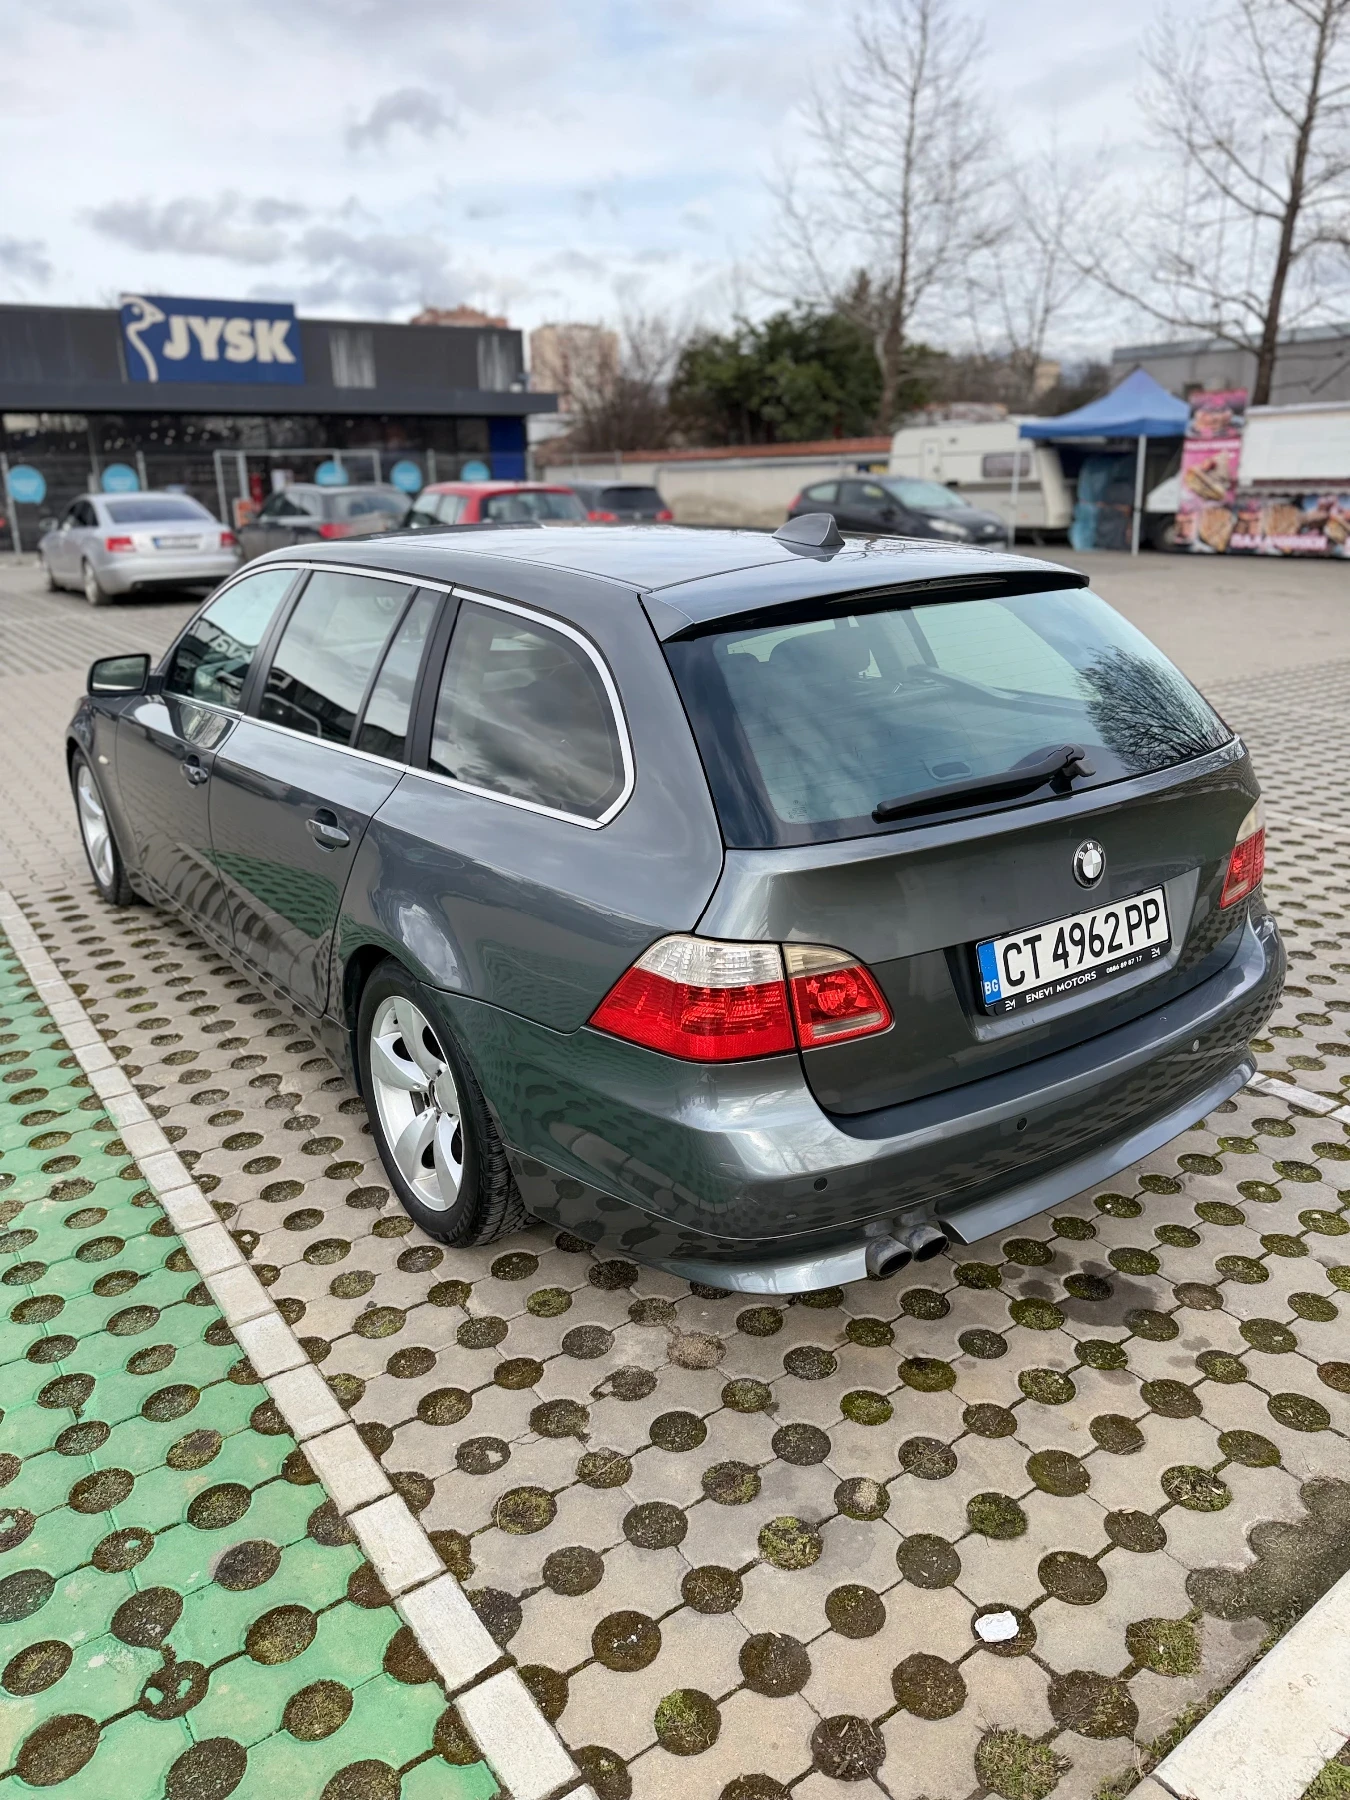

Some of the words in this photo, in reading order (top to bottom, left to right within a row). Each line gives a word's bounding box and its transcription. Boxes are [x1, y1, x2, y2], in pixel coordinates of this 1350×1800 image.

[162, 315, 296, 364] JYSK
[1078, 842, 1103, 860] BMW
[1003, 934, 1042, 987] CT
[1052, 911, 1123, 969] 4962
[1124, 897, 1160, 946] PP
[983, 979, 999, 995] BG
[1025, 986, 1053, 1003] ENEVI
[1056, 971, 1097, 993] MOTORS
